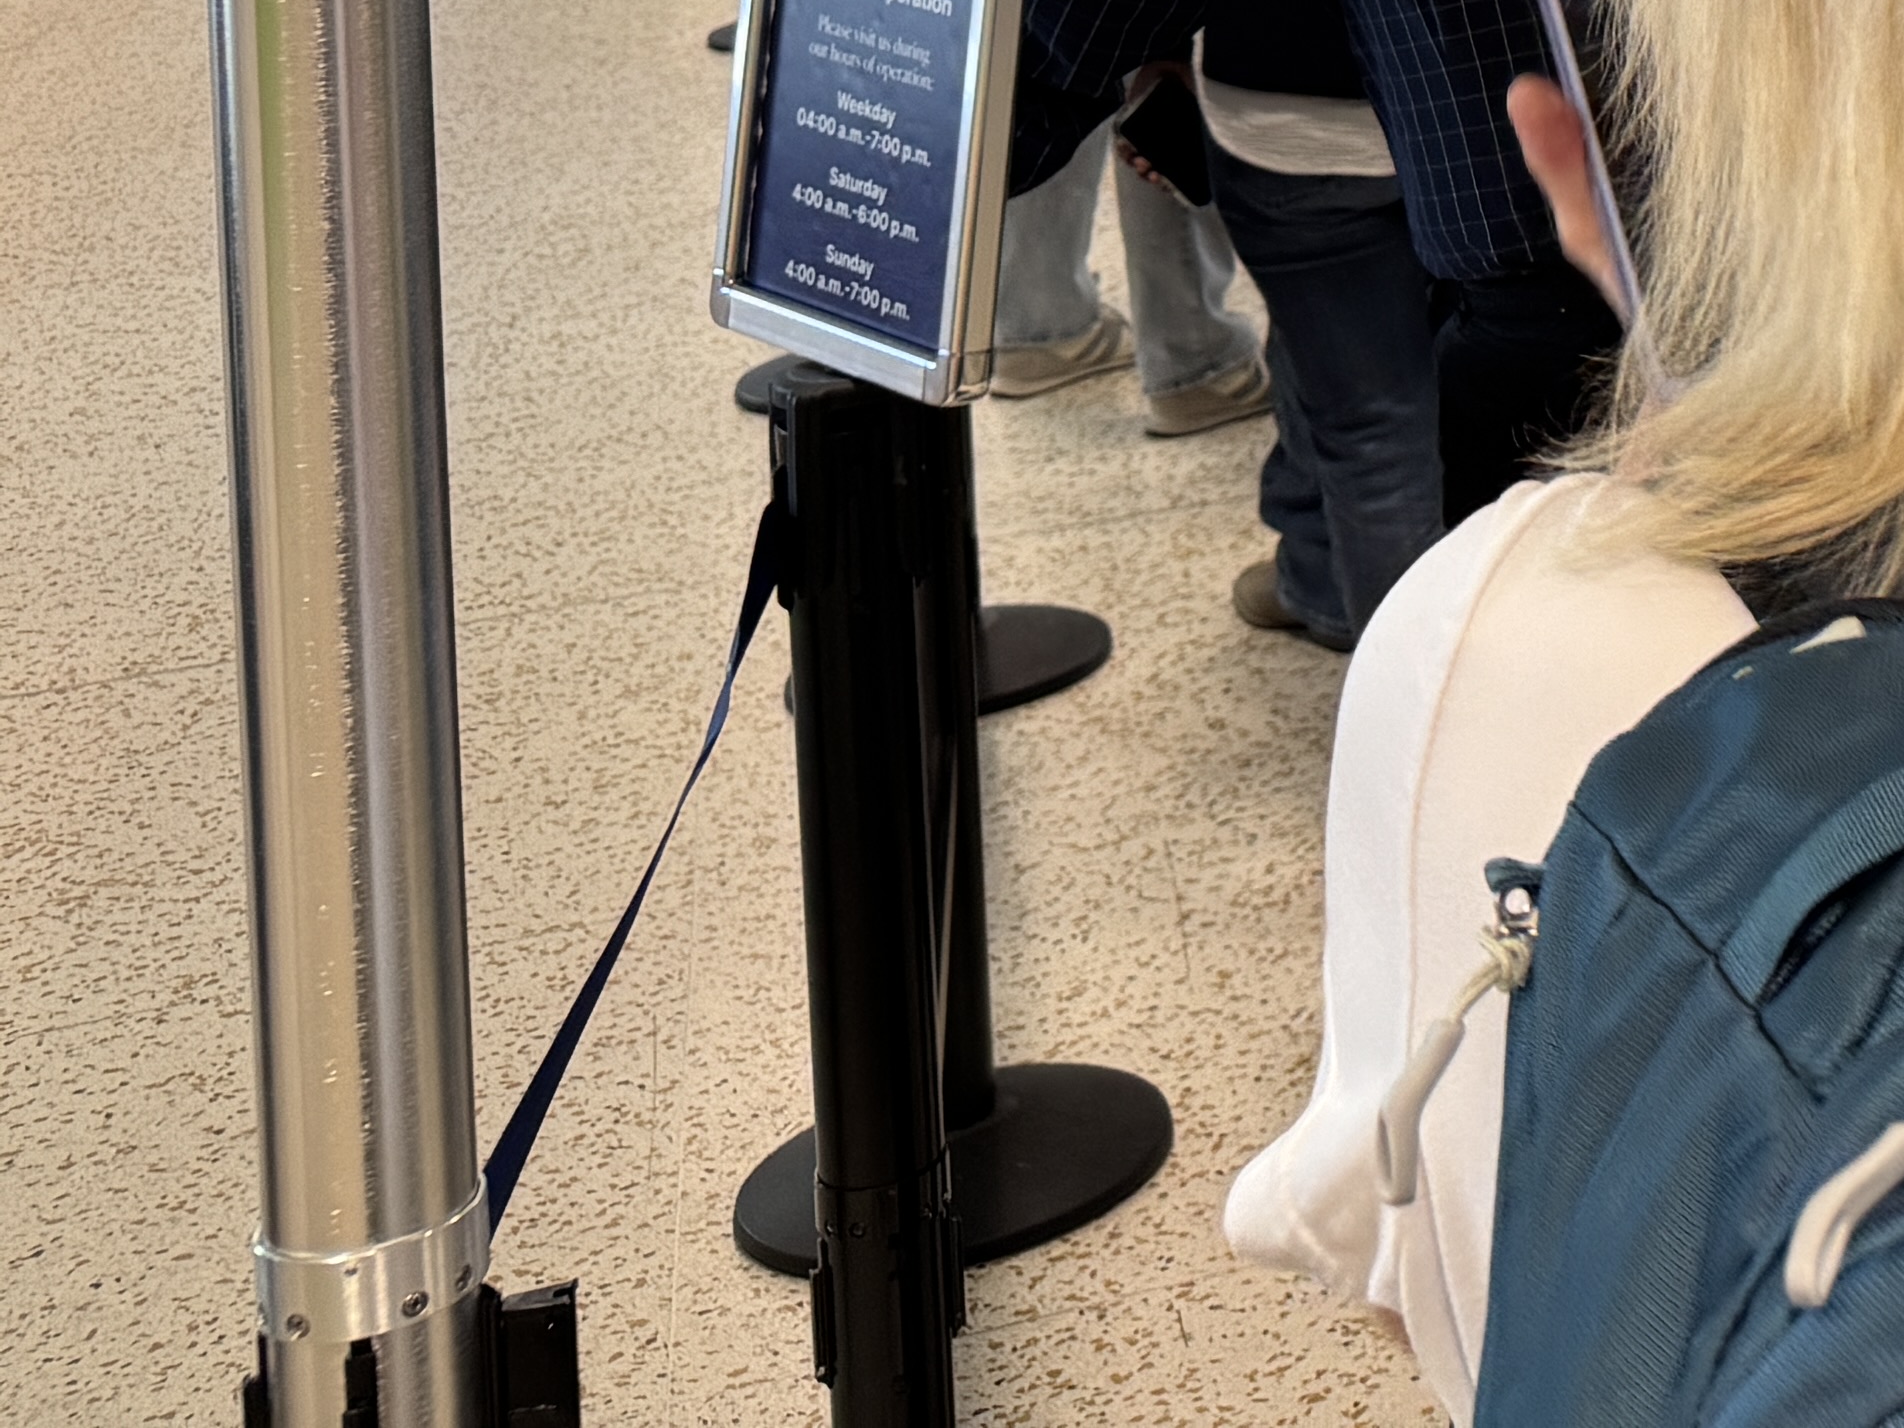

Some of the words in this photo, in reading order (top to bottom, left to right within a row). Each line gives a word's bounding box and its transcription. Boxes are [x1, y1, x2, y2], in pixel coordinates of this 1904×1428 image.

[808, 41, 829, 59] our
[829, 42, 861, 67] hours
[862, 54, 877, 74] of
[818, 12, 853, 41] Please
[892, 36, 931, 68] during
[837, 89, 897, 130] Weekday
[796, 106, 837, 137] 04:00
[901, 143, 932, 168] p.m.
[828, 165, 888, 207] Saturday
[791, 183, 824, 210] 4:00
[889, 219, 920, 243] p.m.
[825, 243, 875, 281] Sunday
[784, 258, 817, 286] 4:00
[880, 296, 911, 321] p.m.
